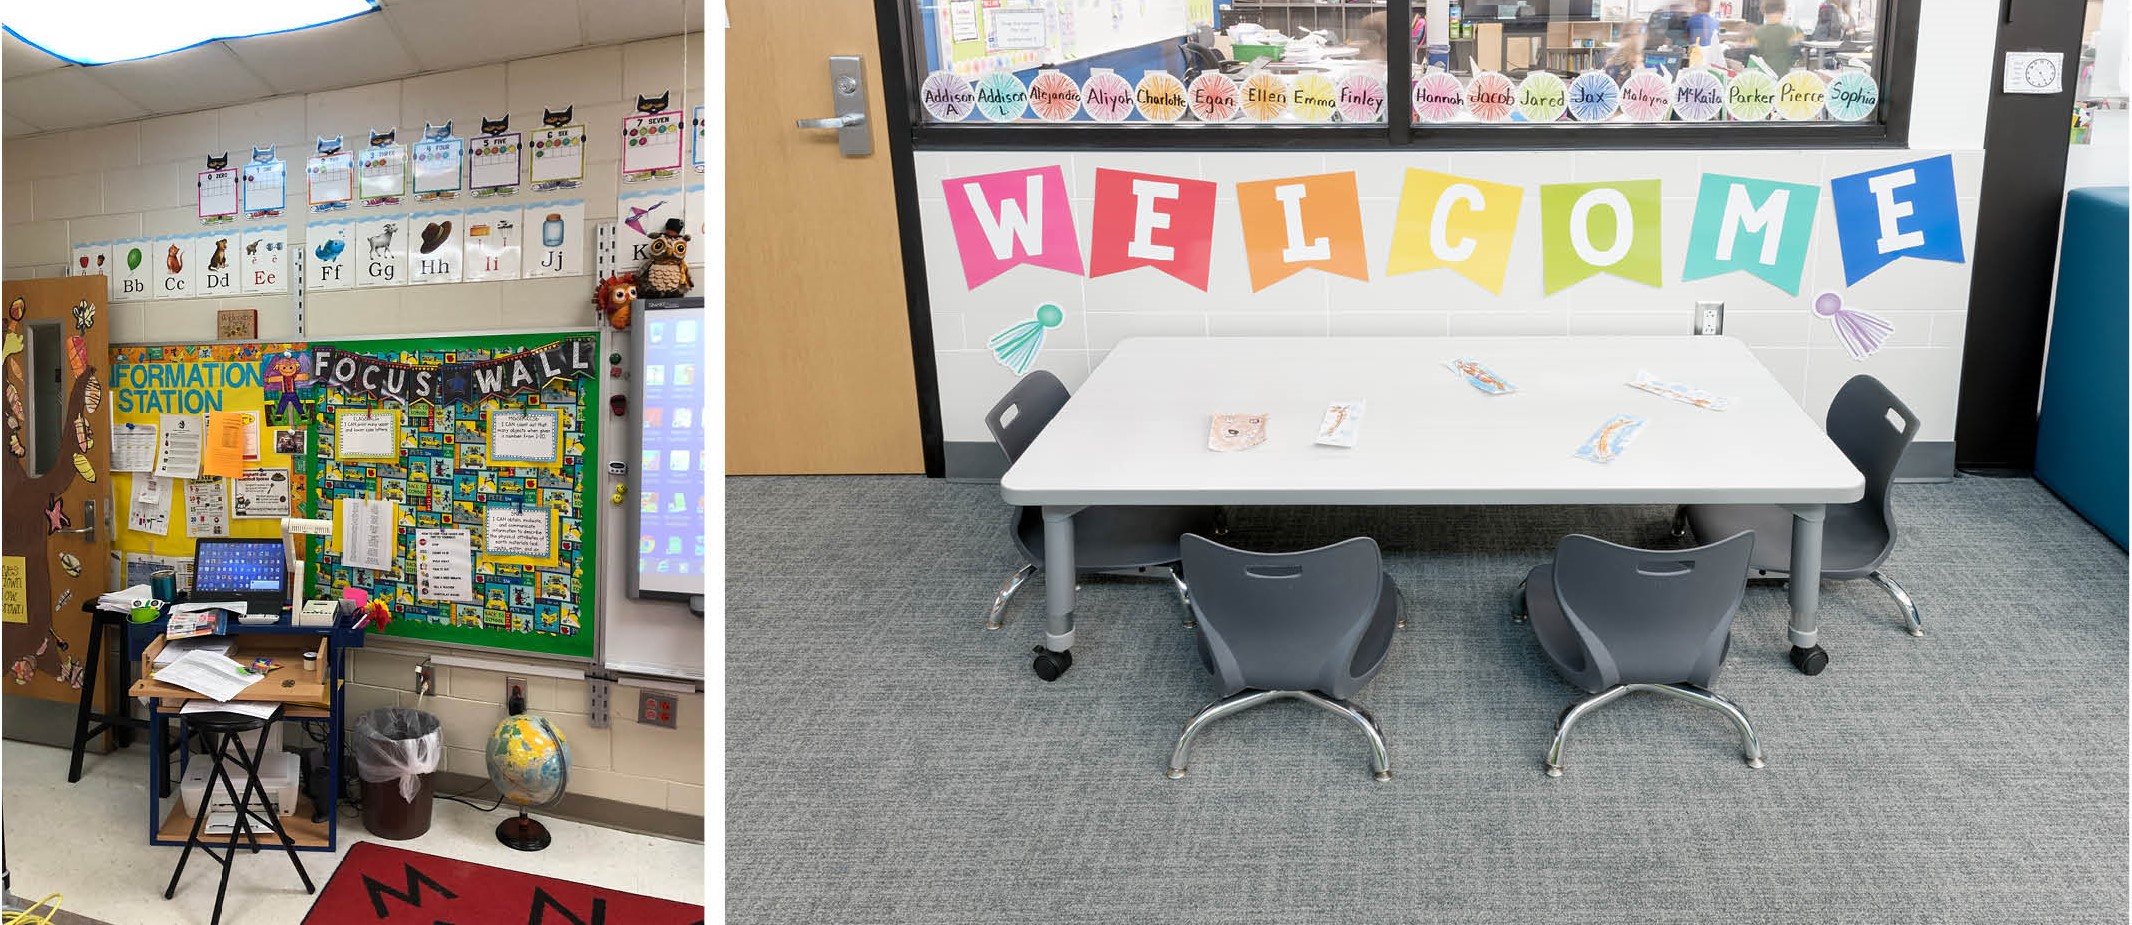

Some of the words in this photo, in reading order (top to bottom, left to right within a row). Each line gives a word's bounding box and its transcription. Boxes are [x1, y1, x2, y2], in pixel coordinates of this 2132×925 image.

[925, 87, 975, 104] Addison
[977, 87, 1028, 103] Addison
[1029, 87, 1081, 105] Alejandro
[1087, 88, 1135, 113] Aliyah
[1136, 88, 1187, 108] Charlotte
[1195, 88, 1234, 114] Egan
[1248, 87, 1287, 104] Ellen
[1294, 90, 1336, 108] Emma
[1340, 86, 1384, 114] Finley
[1416, 88, 1465, 106] Hannah
[1470, 86, 1516, 106] Jacob
[1520, 89, 1565, 107] Jared
[1574, 88, 1606, 104] Jax
[1622, 88, 1668, 107] Malayna
[1729, 85, 1775, 104] Parker
[1780, 83, 1825, 103] Pierce
[1831, 81, 1876, 109] Sophia
[946, 103, 959, 116] A
[999, 104, 1009, 116] L
[637, 118, 644, 127] 7
[648, 116, 670, 125] SEVEN
[483, 139, 489, 147] 5
[493, 137, 507, 145] FIVE
[962, 168, 1925, 266] WELCOME
[420, 259, 450, 275] Hh
[541, 250, 564, 272] Jj
[254, 271, 276, 285] Ee
[321, 264, 343, 281] Ff
[368, 261, 394, 280] Gg
[123, 279, 144, 293] Bb
[164, 277, 185, 291] Cc
[206, 272, 230, 288] Dd
[109, 362, 264, 389] FORMATION
[314, 351, 432, 397] FOCUS
[475, 340, 590, 395] WALL
[117, 387, 223, 415] STATION
[361, 862, 459, 919] M
